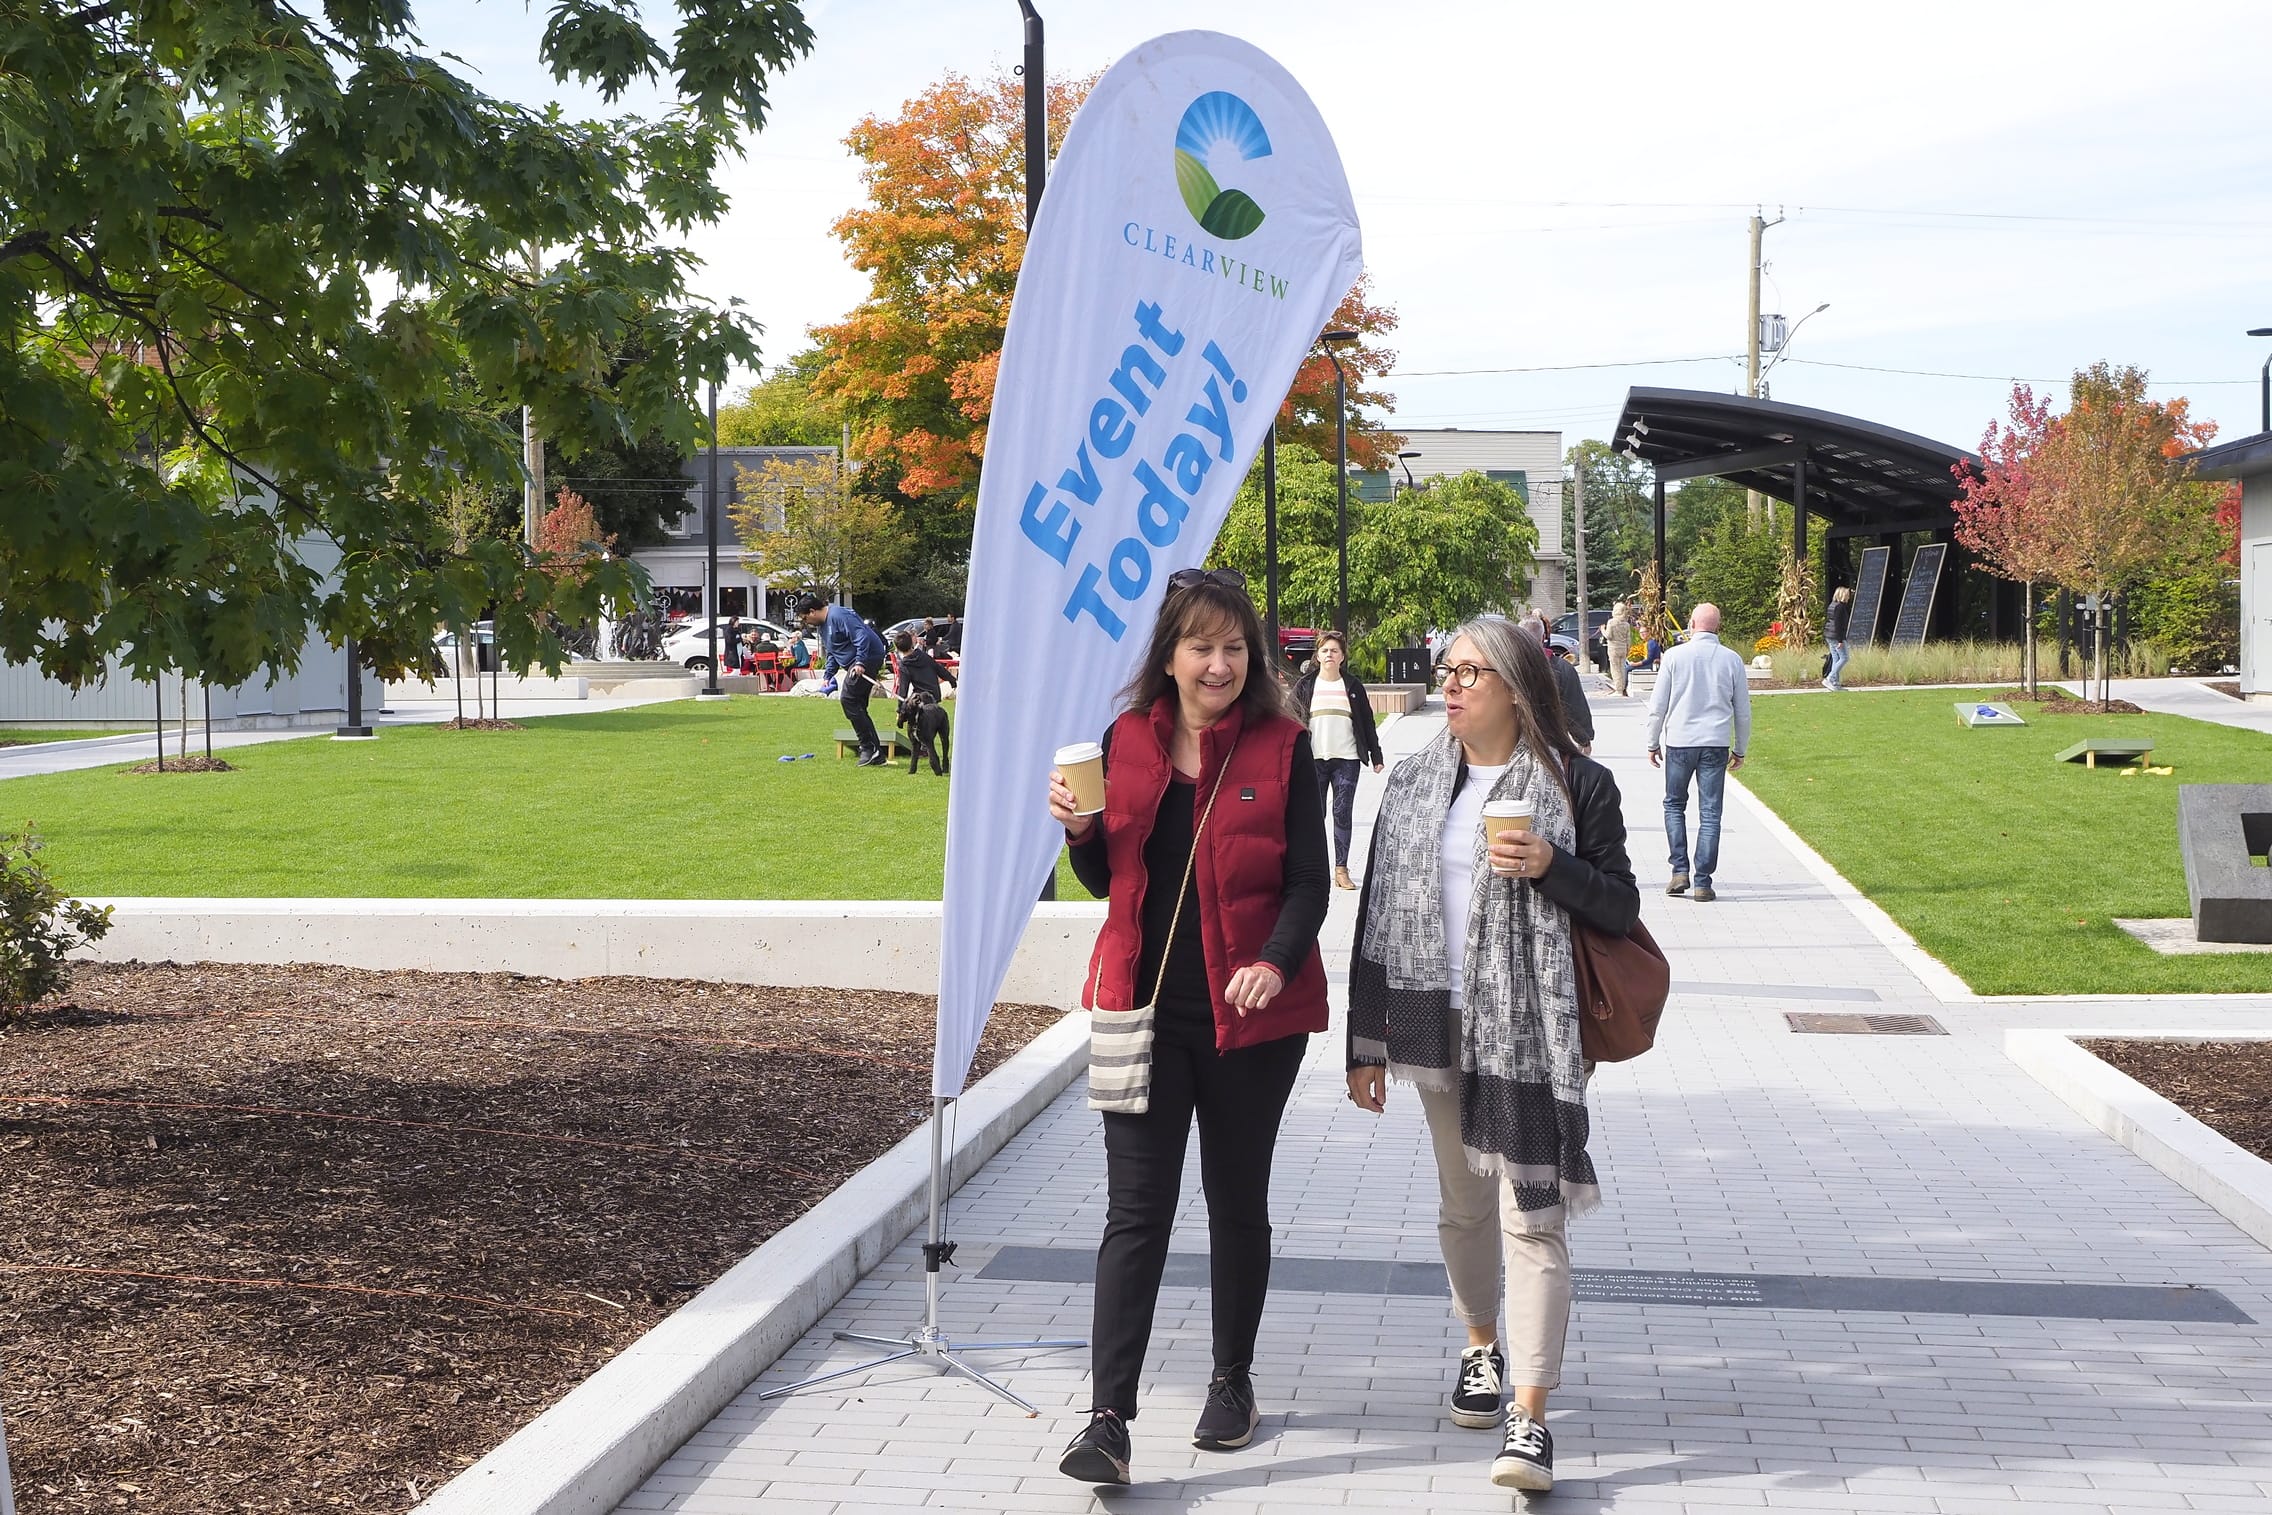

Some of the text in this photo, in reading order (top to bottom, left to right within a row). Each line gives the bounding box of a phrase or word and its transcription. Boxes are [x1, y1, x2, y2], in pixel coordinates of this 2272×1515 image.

[1123, 222, 1290, 302] CLEARVIEW
[1019, 300, 1186, 566] Event
[1063, 340, 1249, 642] Today!
